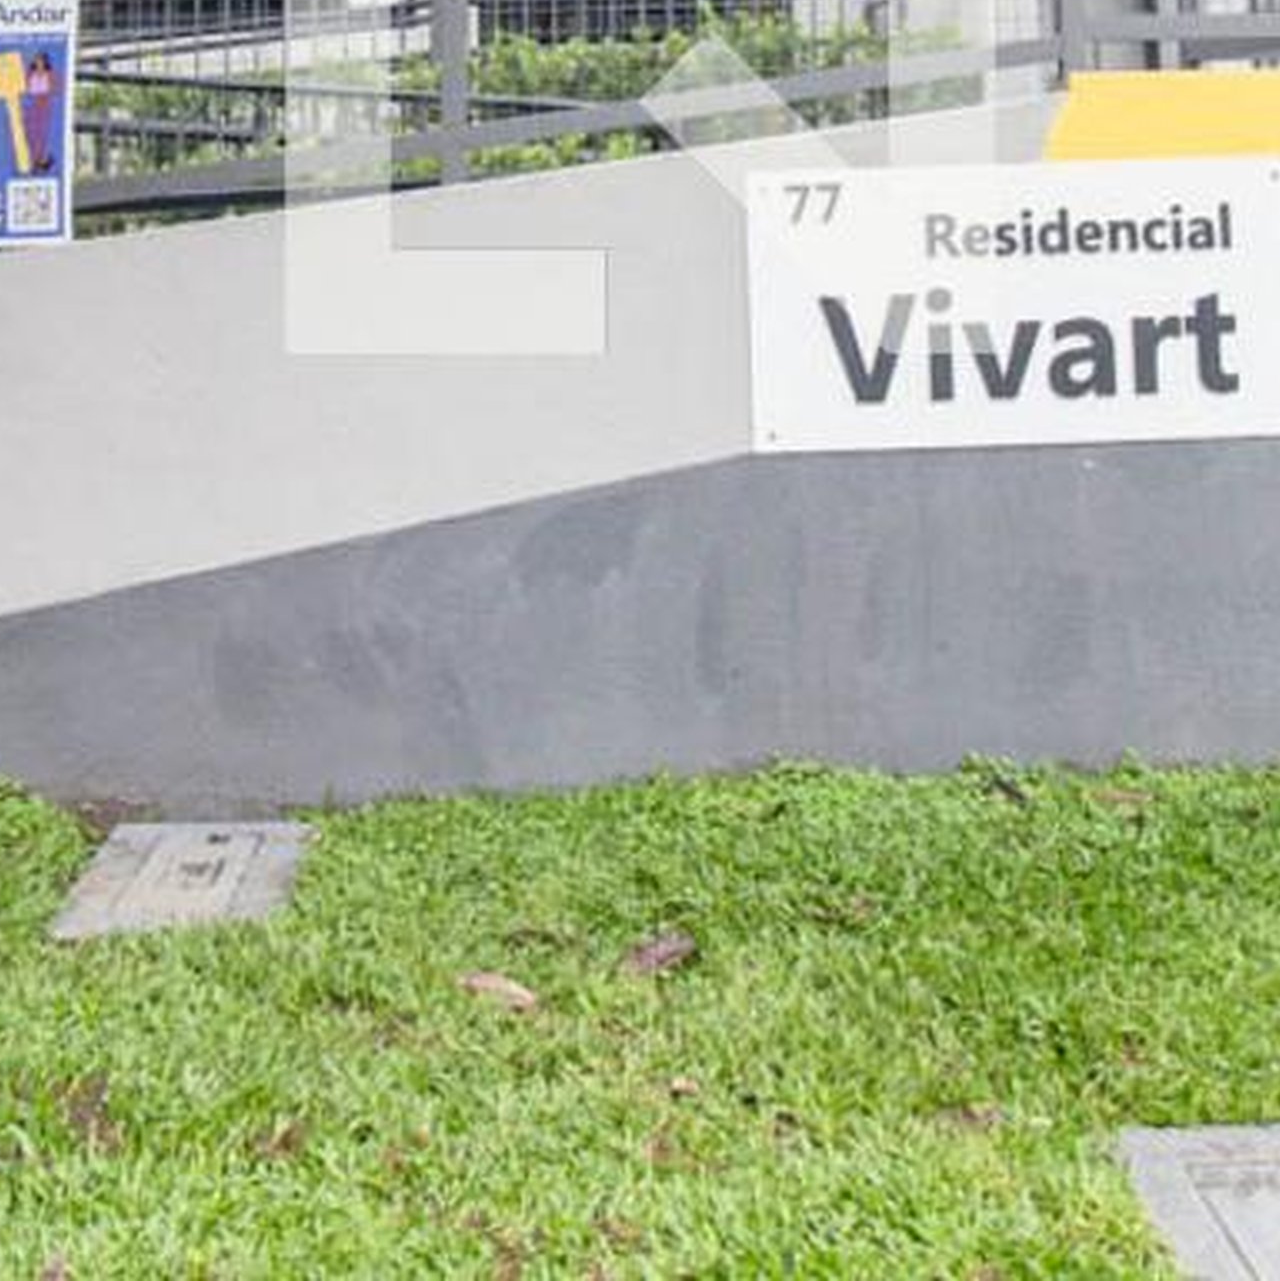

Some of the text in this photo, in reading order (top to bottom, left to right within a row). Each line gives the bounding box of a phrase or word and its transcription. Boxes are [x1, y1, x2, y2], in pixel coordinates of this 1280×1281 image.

[785, 183, 842, 225] 77
[924, 203, 1233, 260] Residencial
[819, 287, 1240, 406] Vivart
